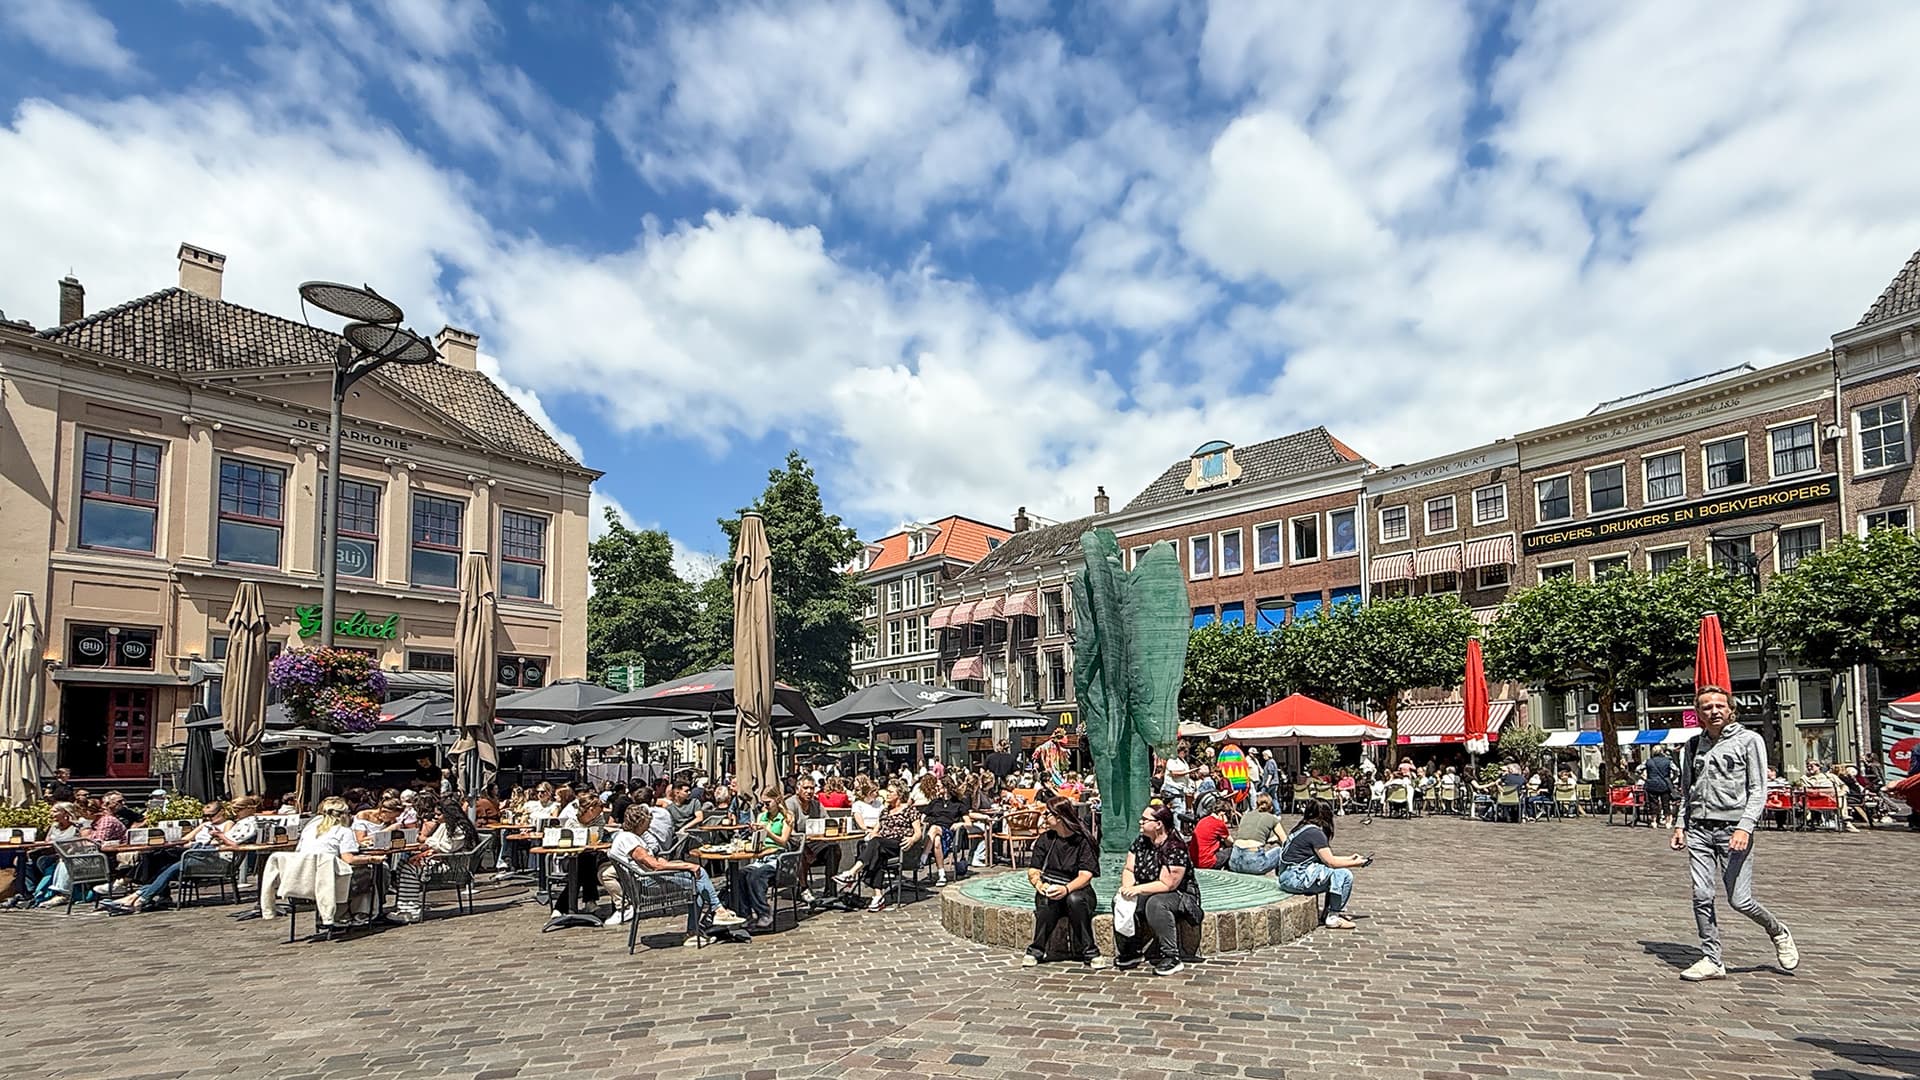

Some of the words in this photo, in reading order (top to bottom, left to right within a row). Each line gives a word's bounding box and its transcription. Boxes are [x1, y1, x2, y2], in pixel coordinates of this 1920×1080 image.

[1719, 397, 1741, 410] 1836
[1527, 527, 1596, 547] UITGEVERS,
[1600, 513, 1670, 535] DRUKKERS
[1674, 508, 1694, 522] EN
[1699, 483, 1831, 517] BOEKVERKOPERS
[295, 603, 400, 640] Golsch
[1587, 701, 1631, 713] OLY
[1734, 693, 1768, 707] NLY
